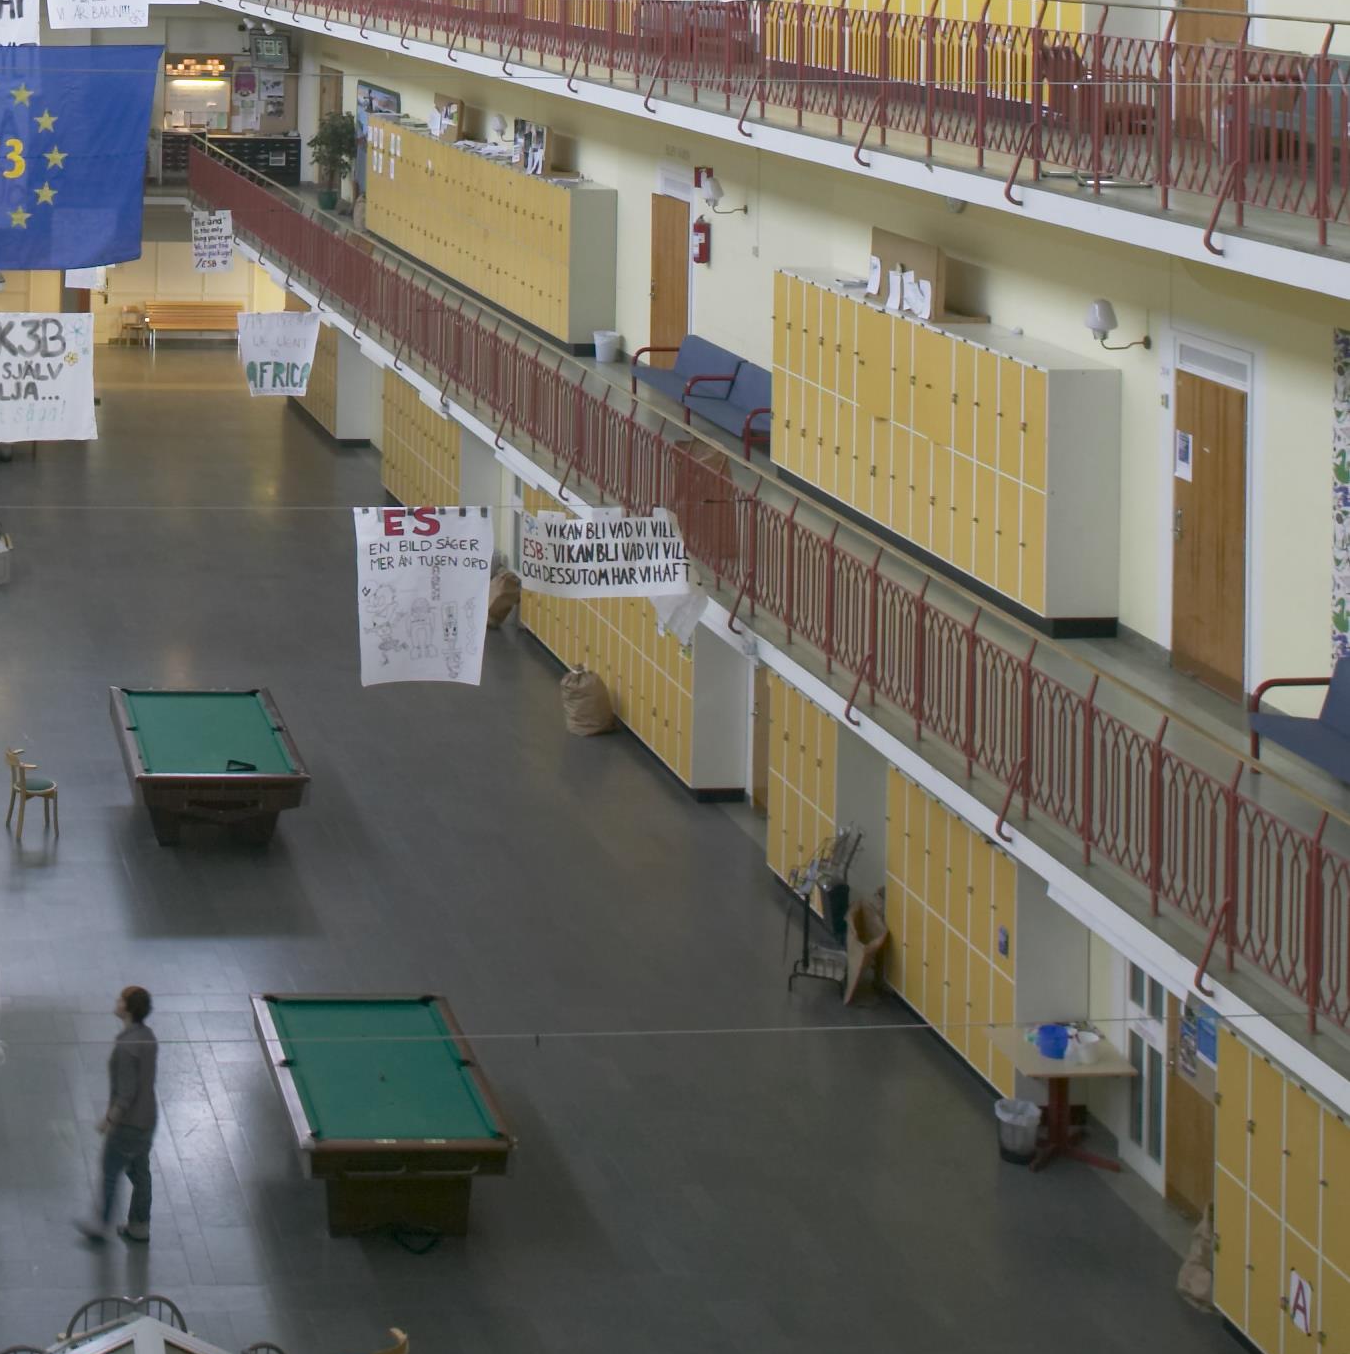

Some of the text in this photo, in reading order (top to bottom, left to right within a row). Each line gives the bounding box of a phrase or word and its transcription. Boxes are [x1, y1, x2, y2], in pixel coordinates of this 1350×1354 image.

[4, 359, 64, 382] SJÄLV
[383, 506, 441, 537] ES
[544, 521, 557, 539] VI
[558, 522, 584, 541] KAN
[586, 521, 606, 540] BLI
[609, 522, 633, 540] VAD
[635, 521, 647, 538] VI
[651, 520, 677, 538] VILL
[369, 540, 390, 556] EN
[398, 539, 433, 553] BILD
[567, 543, 594, 564] KAN
[596, 543, 619, 563] BLI
[621, 542, 644, 562] VAD
[646, 542, 659, 561] VI
[662, 542, 691, 560] VILL
[370, 556, 395, 572] MER
[419, 555, 459, 568] TUSEN
[462, 556, 489, 571] ORD
[521, 560, 691, 586] OCH DESSUTOM HAR VI HAFT
[1291, 1279, 1309, 1333] A
